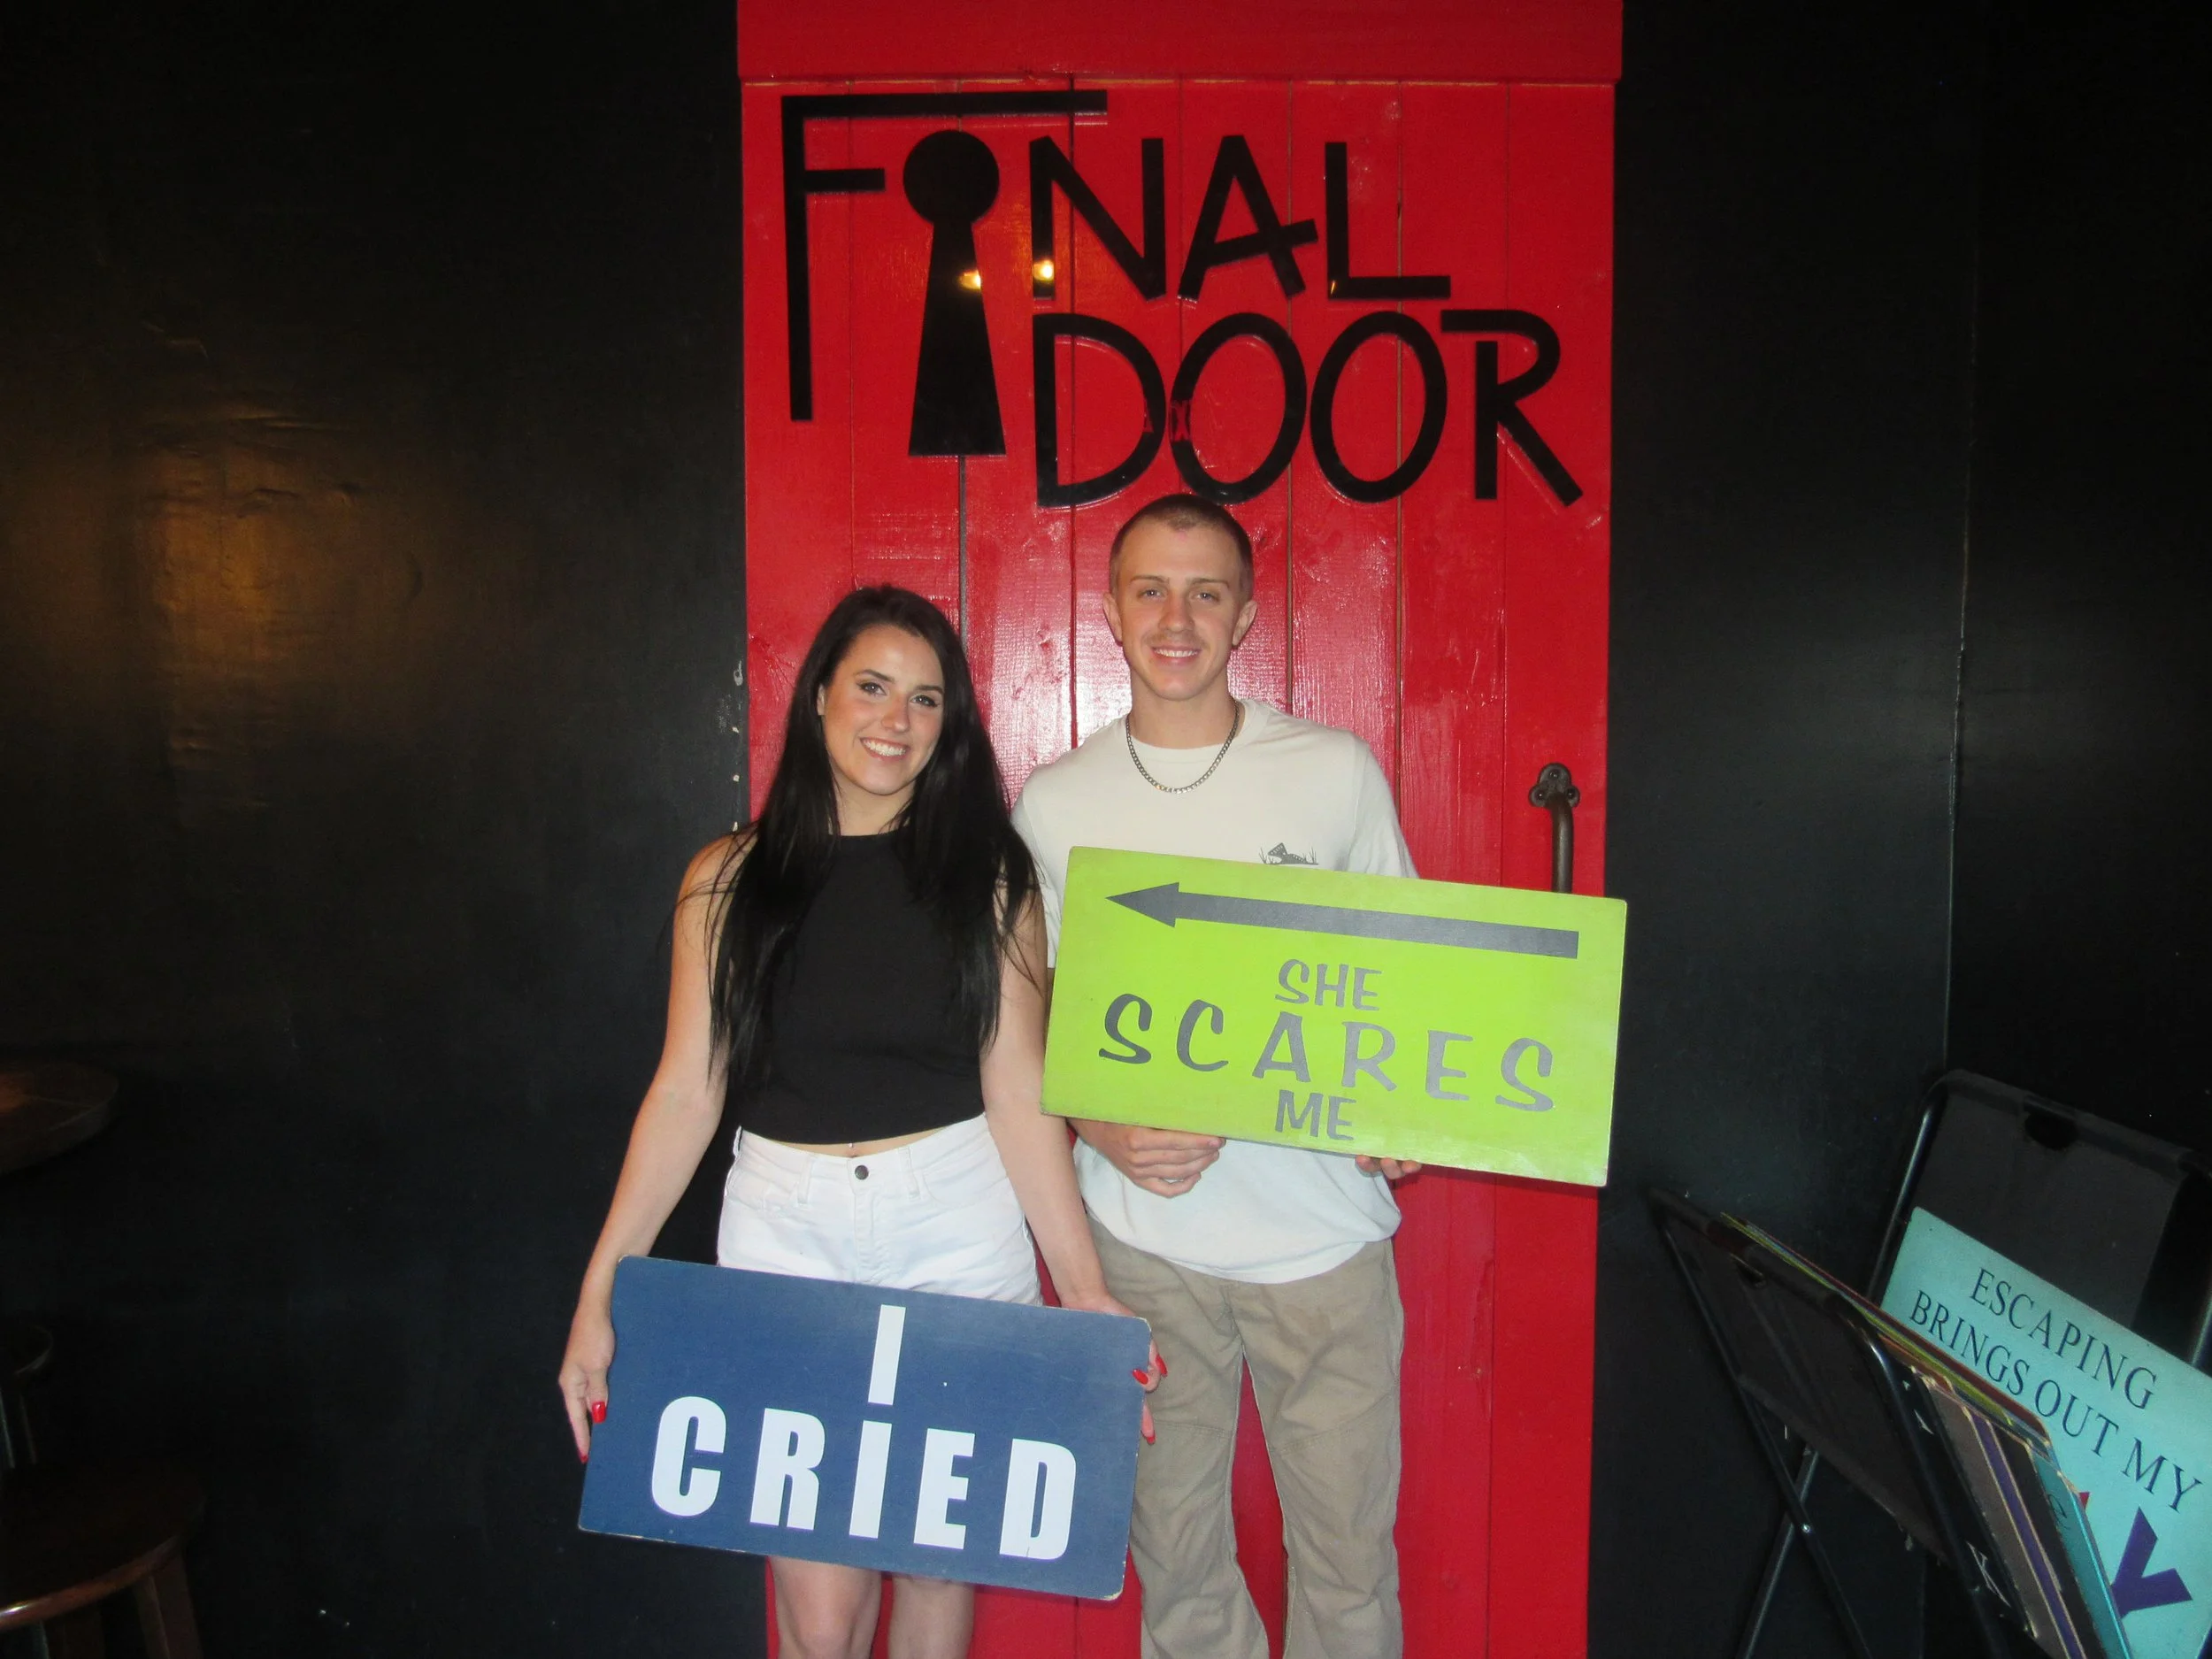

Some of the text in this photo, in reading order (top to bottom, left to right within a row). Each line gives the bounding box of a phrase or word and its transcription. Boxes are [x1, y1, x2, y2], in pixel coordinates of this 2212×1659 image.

[1033, 310, 1583, 509] DOOR
[1275, 958, 1383, 1012] SHE
[1098, 993, 1555, 1112] SCARES
[1274, 1089, 1357, 1141] ME
[867, 1304, 906, 1406] I
[1909, 1290, 2032, 1396] BRINGS
[2035, 1379, 2120, 1458] OUT
[2122, 1438, 2202, 1516] MY
[1970, 1268, 2159, 1410] ESCAPING
[651, 1395, 1077, 1561] CRIED
